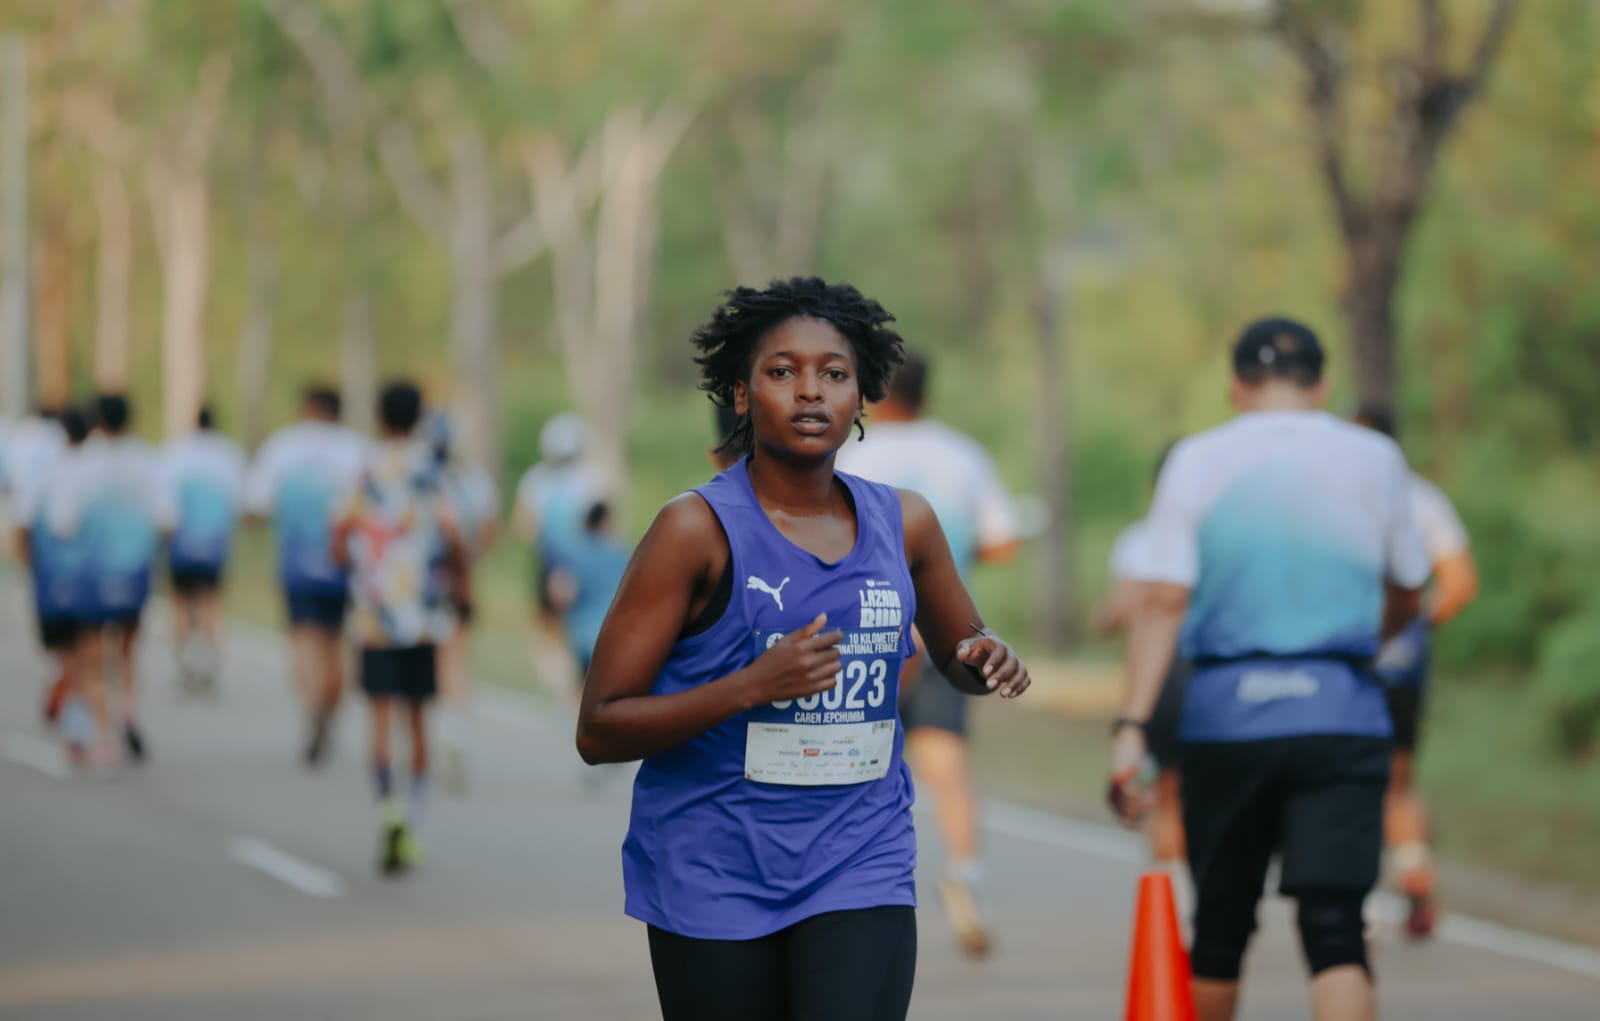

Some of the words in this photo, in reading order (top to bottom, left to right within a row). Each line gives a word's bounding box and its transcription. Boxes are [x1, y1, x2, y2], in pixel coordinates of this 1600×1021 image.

[859, 589, 902, 608] LAZADA
[849, 632, 859, 645] 10
[875, 641, 898, 654] FEMALE
[771, 659, 888, 710] 023
[794, 711, 822, 724] CAREN
[823, 710, 865, 724] JEPCHUMBA
